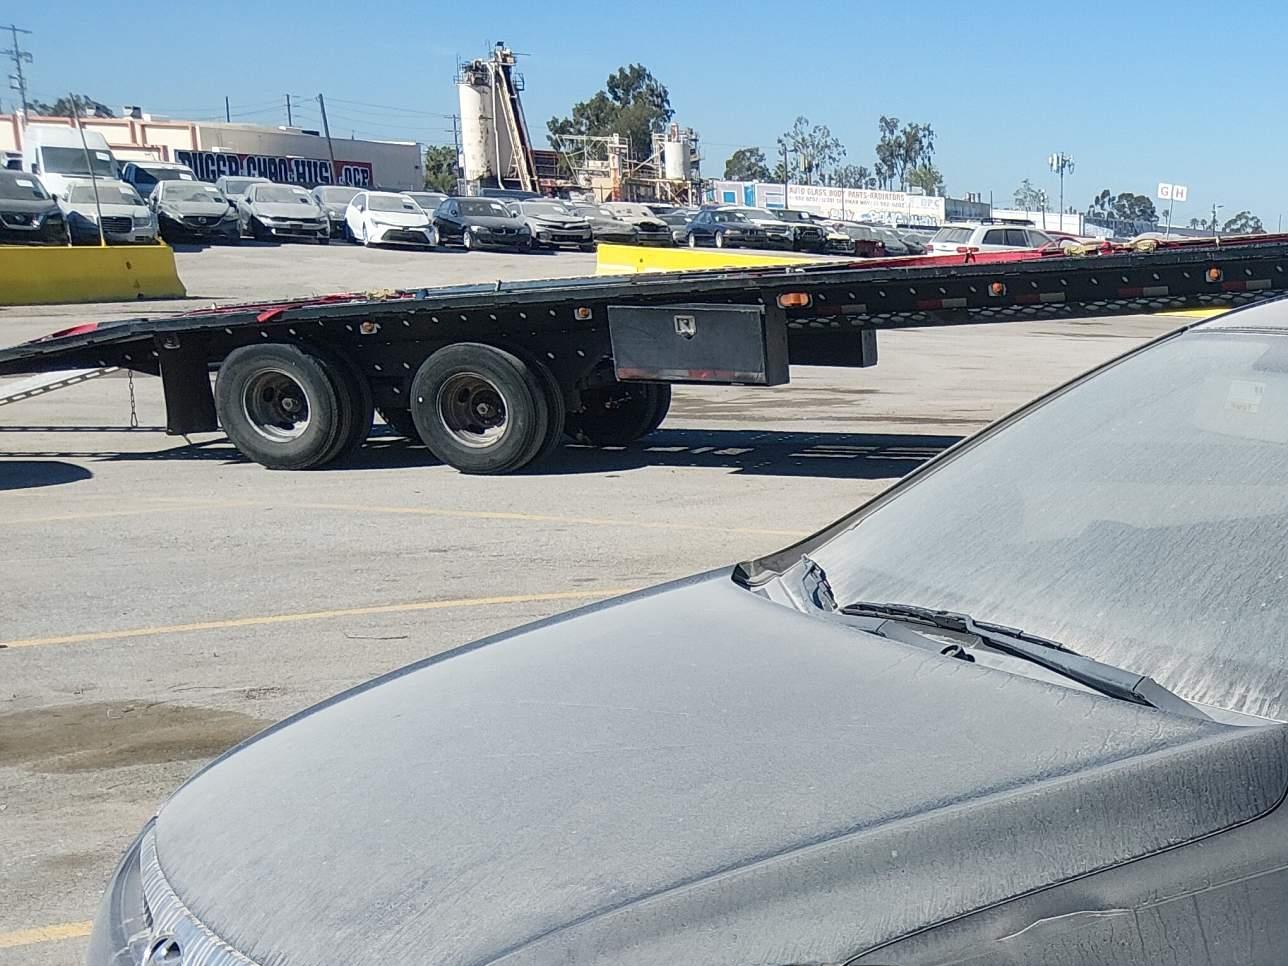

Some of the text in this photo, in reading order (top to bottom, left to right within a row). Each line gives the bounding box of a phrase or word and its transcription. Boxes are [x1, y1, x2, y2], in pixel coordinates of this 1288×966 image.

[807, 188, 827, 197] GLASS
[1161, 187, 1169, 197] G
[1176, 188, 1184, 198] H
